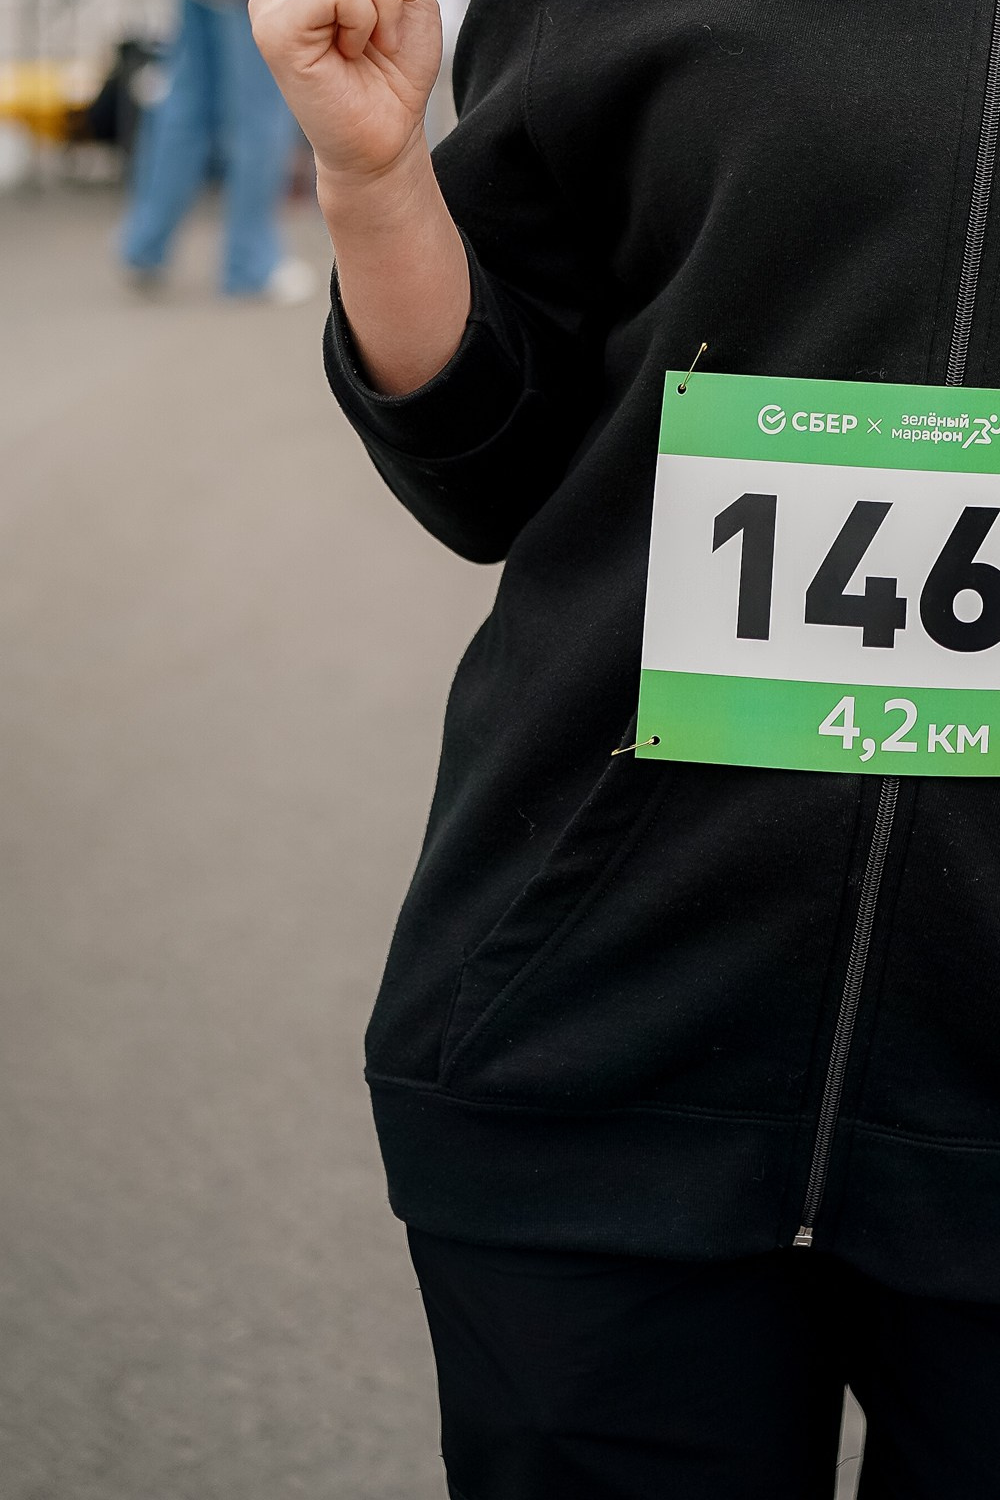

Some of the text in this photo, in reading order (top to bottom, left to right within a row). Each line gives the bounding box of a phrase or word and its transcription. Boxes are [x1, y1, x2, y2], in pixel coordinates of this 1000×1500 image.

[791, 411, 858, 434] СБЕР
[901, 412, 970, 429] зелёный
[891, 427, 963, 444] марафон
[818, 695, 918, 762] 4,2
